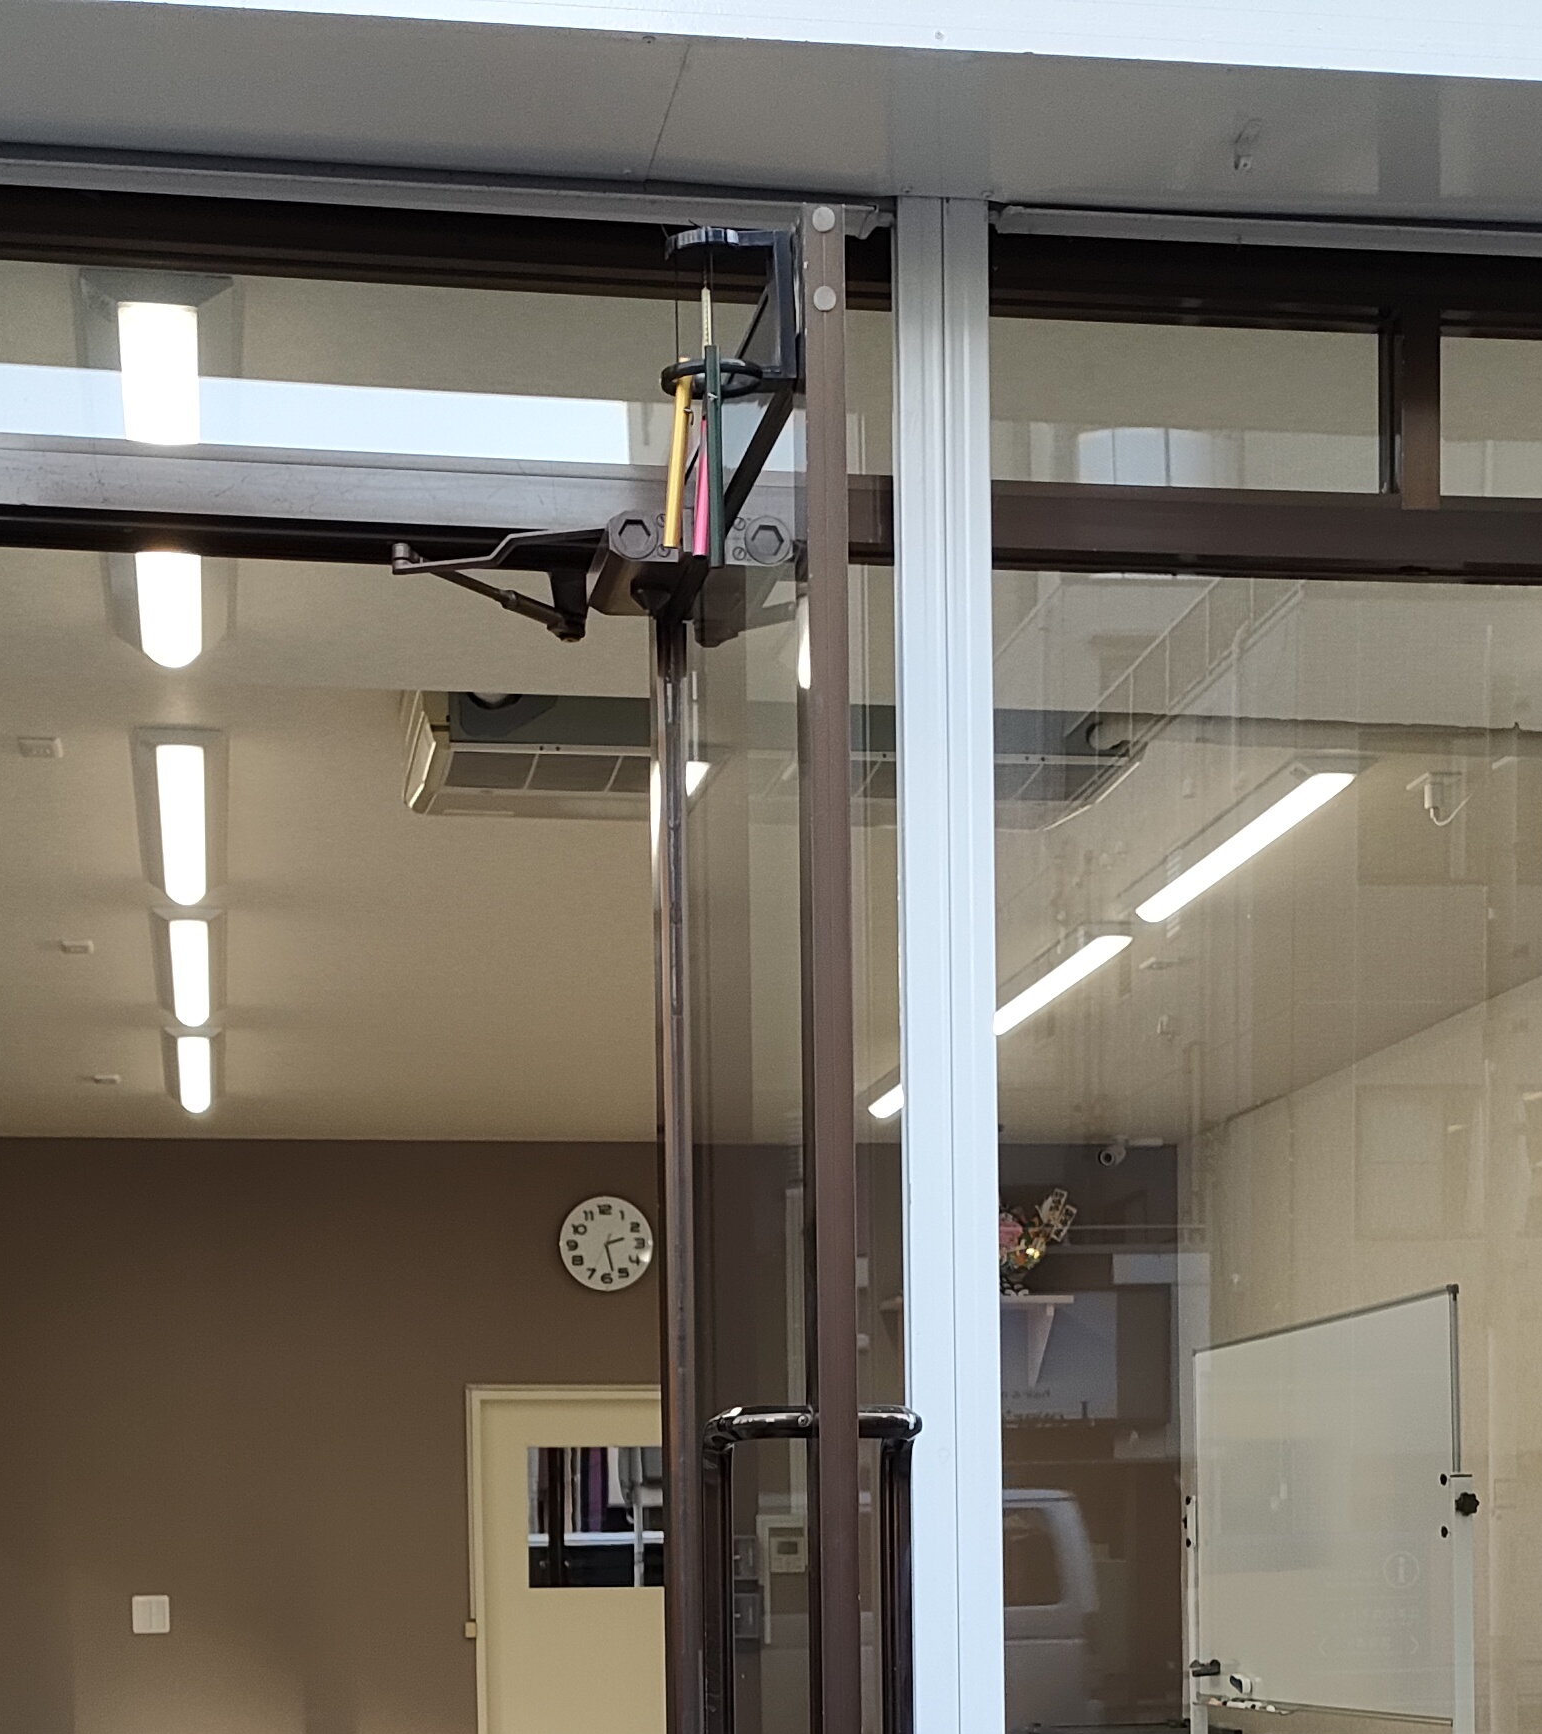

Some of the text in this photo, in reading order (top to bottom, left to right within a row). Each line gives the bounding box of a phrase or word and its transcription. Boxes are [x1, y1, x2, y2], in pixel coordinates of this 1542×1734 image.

[597, 1204, 612, 1215] 12
[619, 1209, 625, 1220] 1
[583, 1210, 594, 1221] 11
[571, 1223, 587, 1235] 10
[630, 1222, 640, 1233] 2
[566, 1239, 578, 1251] 9
[634, 1237, 645, 1249] 3
[571, 1255, 584, 1266] 8
[629, 1255, 640, 1266] 4
[587, 1268, 596, 1280] 7
[618, 1267, 629, 1278] 5
[601, 1273, 613, 1284] 6
